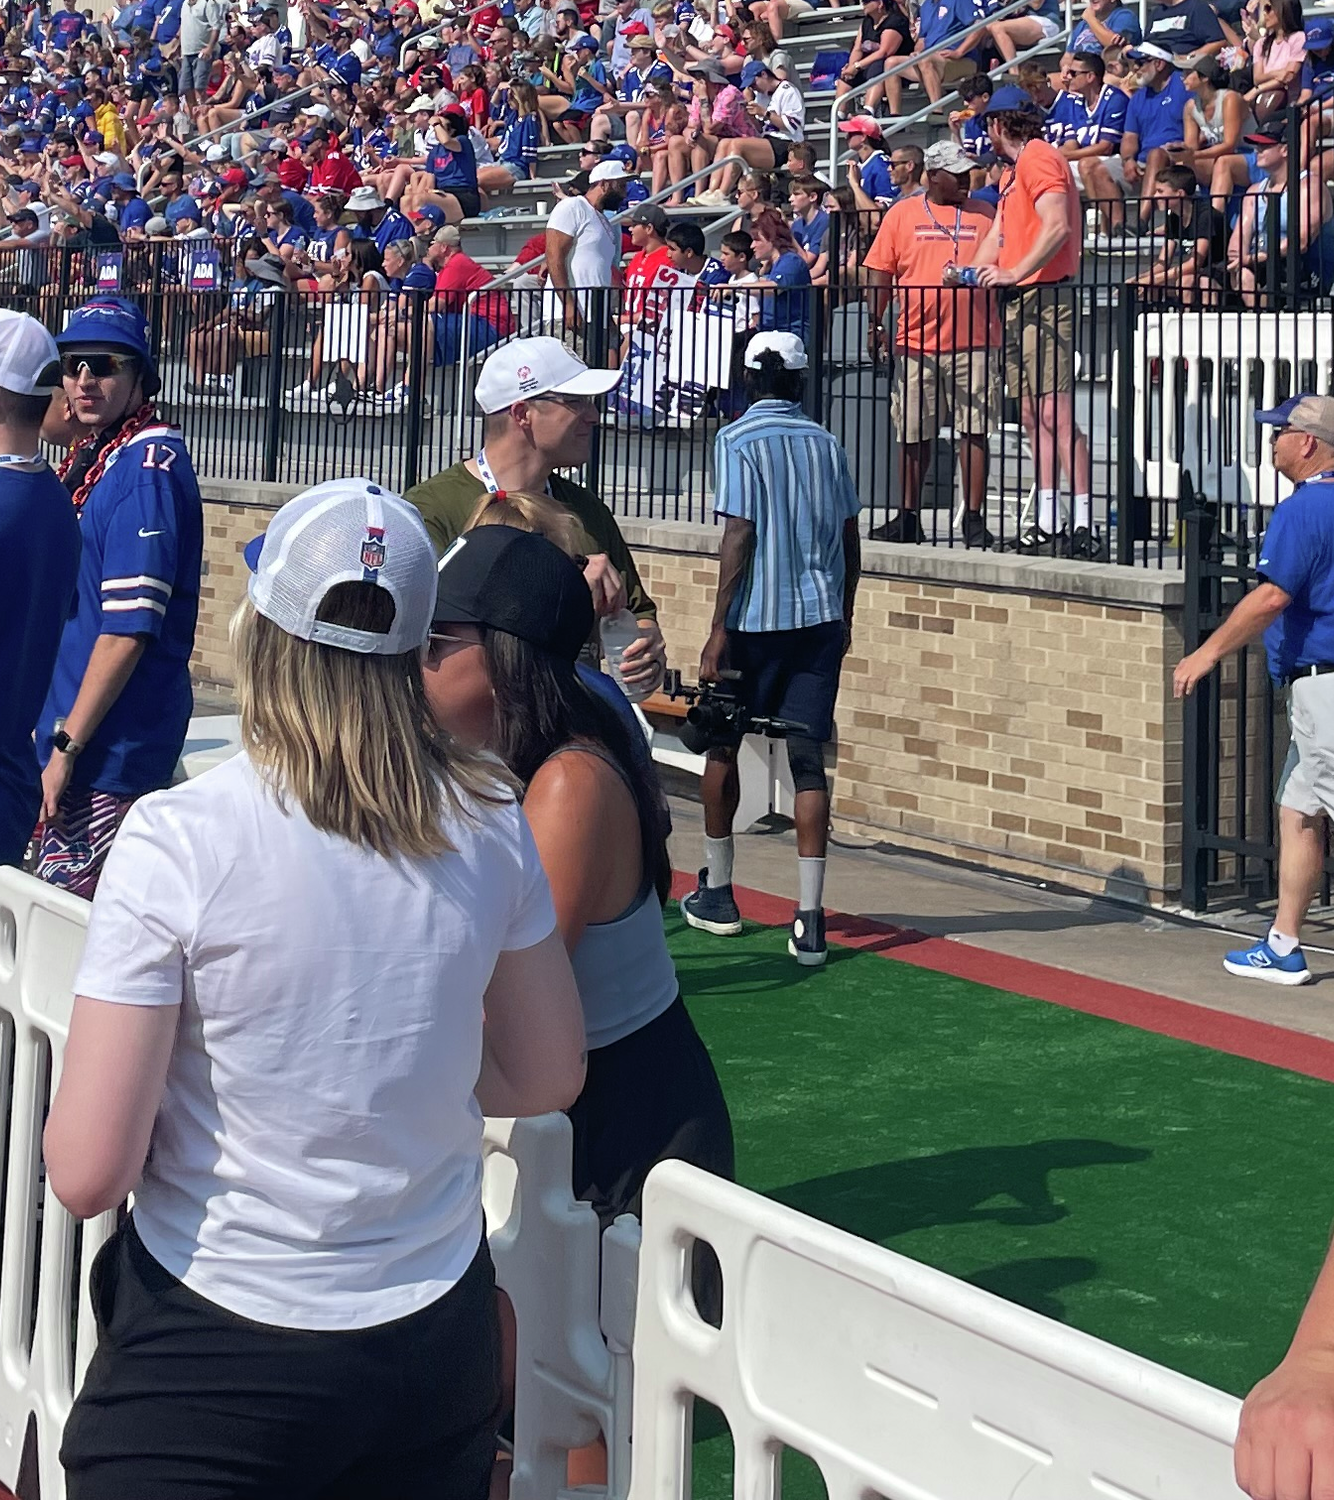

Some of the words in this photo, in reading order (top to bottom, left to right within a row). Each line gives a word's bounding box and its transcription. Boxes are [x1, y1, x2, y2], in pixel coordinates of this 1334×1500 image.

[99, 265, 118, 281] ADA
[193, 263, 214, 279] ADA
[142, 443, 177, 472] 17
